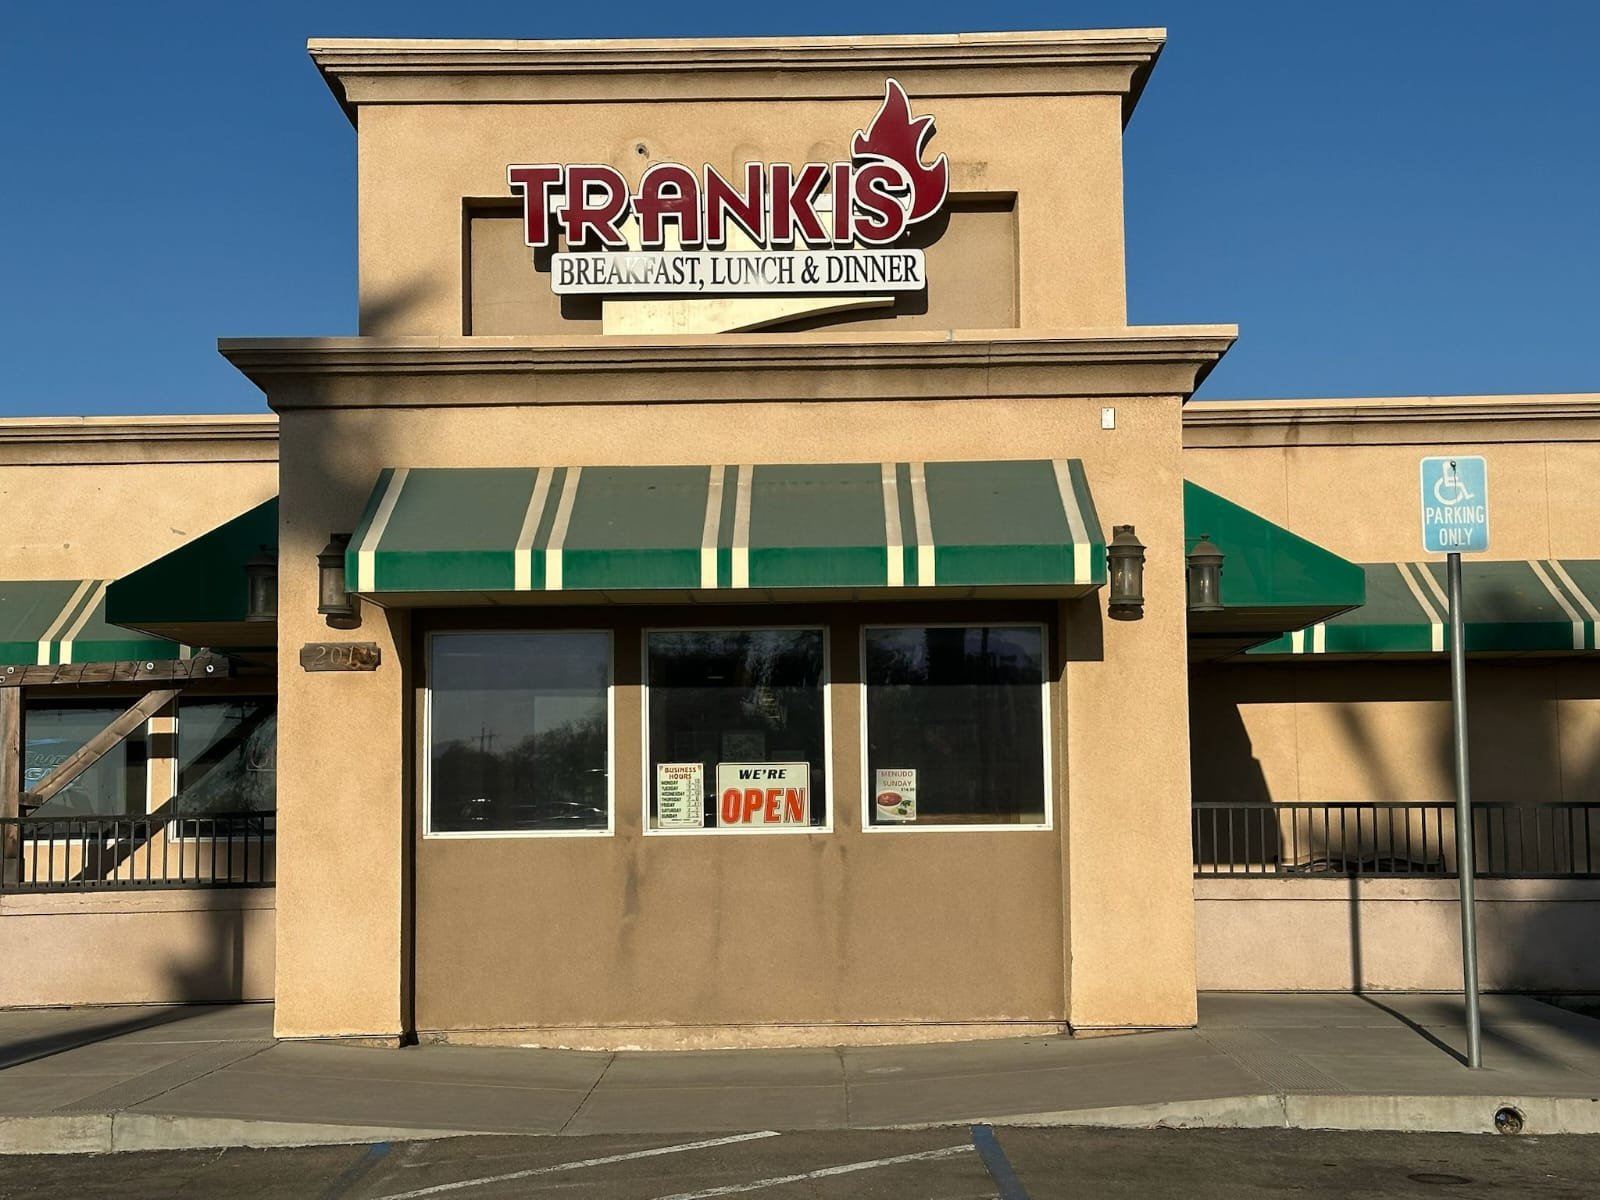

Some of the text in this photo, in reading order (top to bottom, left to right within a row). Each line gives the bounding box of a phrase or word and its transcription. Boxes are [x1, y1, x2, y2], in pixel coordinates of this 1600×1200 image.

[507, 162, 913, 248] TRANKIS
[559, 254, 921, 291] BREAKFAST, LUNCH & DINNER
[1426, 505, 1485, 525] PARKING
[1439, 527, 1473, 546] ONLY
[739, 769, 787, 780] WE'RE
[721, 787, 806, 825] OPEN
